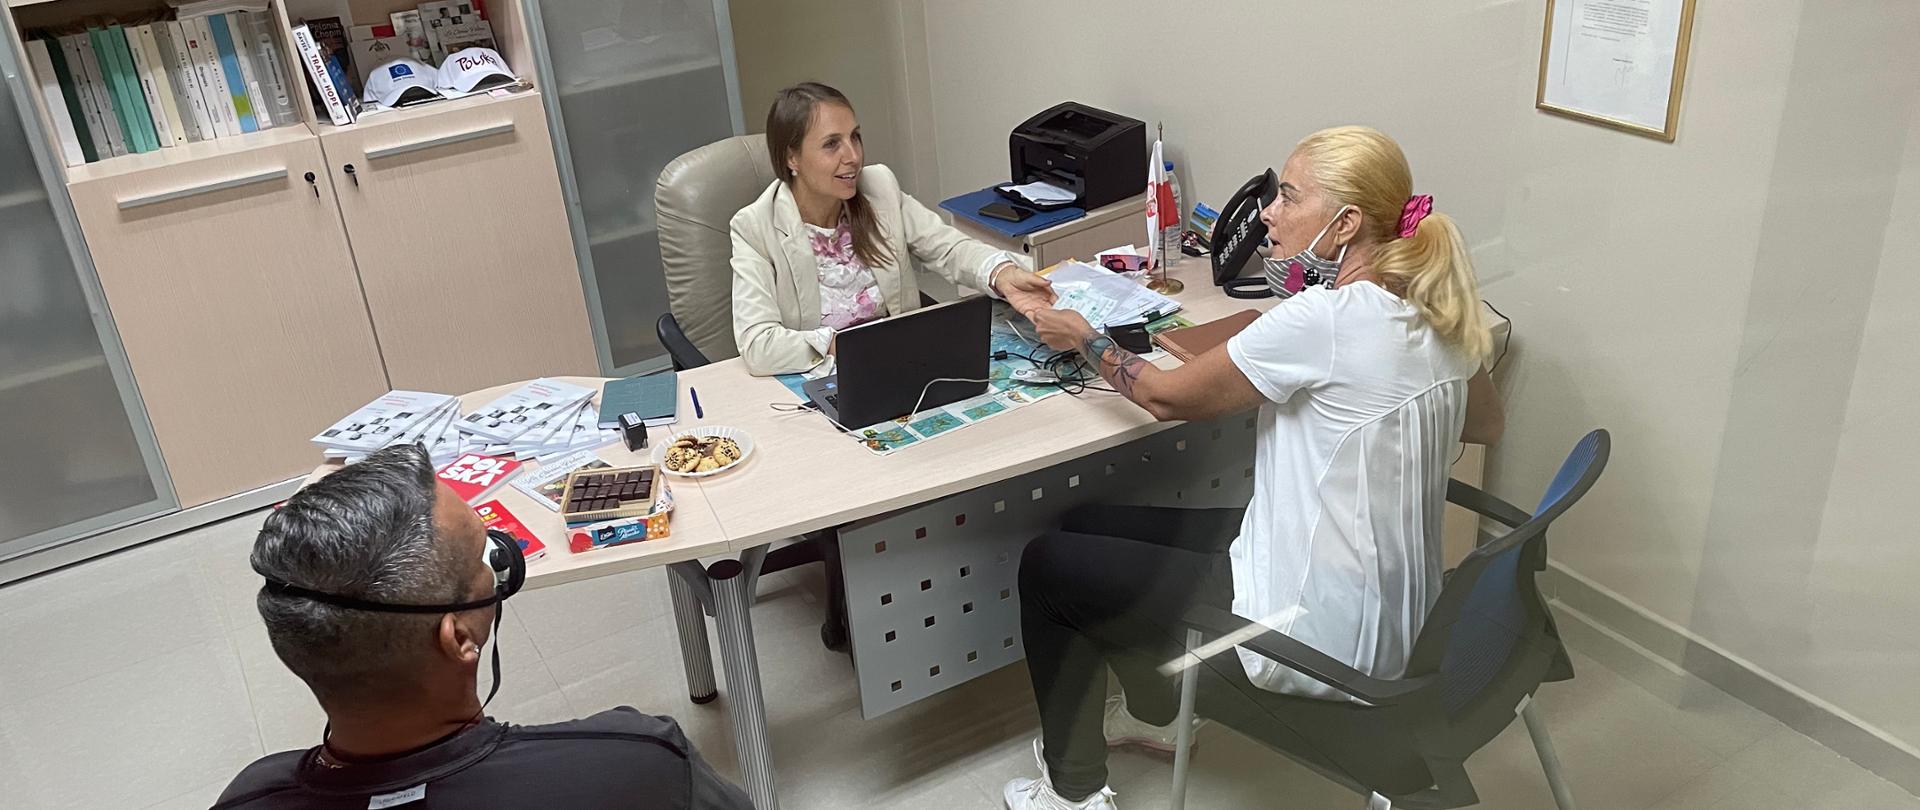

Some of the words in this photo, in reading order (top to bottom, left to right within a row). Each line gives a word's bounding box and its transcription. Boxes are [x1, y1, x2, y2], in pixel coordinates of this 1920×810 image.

[311, 54, 325, 78] TRAIL
[325, 84, 339, 107] HOPE
[458, 454, 508, 475] POL
[438, 466, 496, 487] SKA
